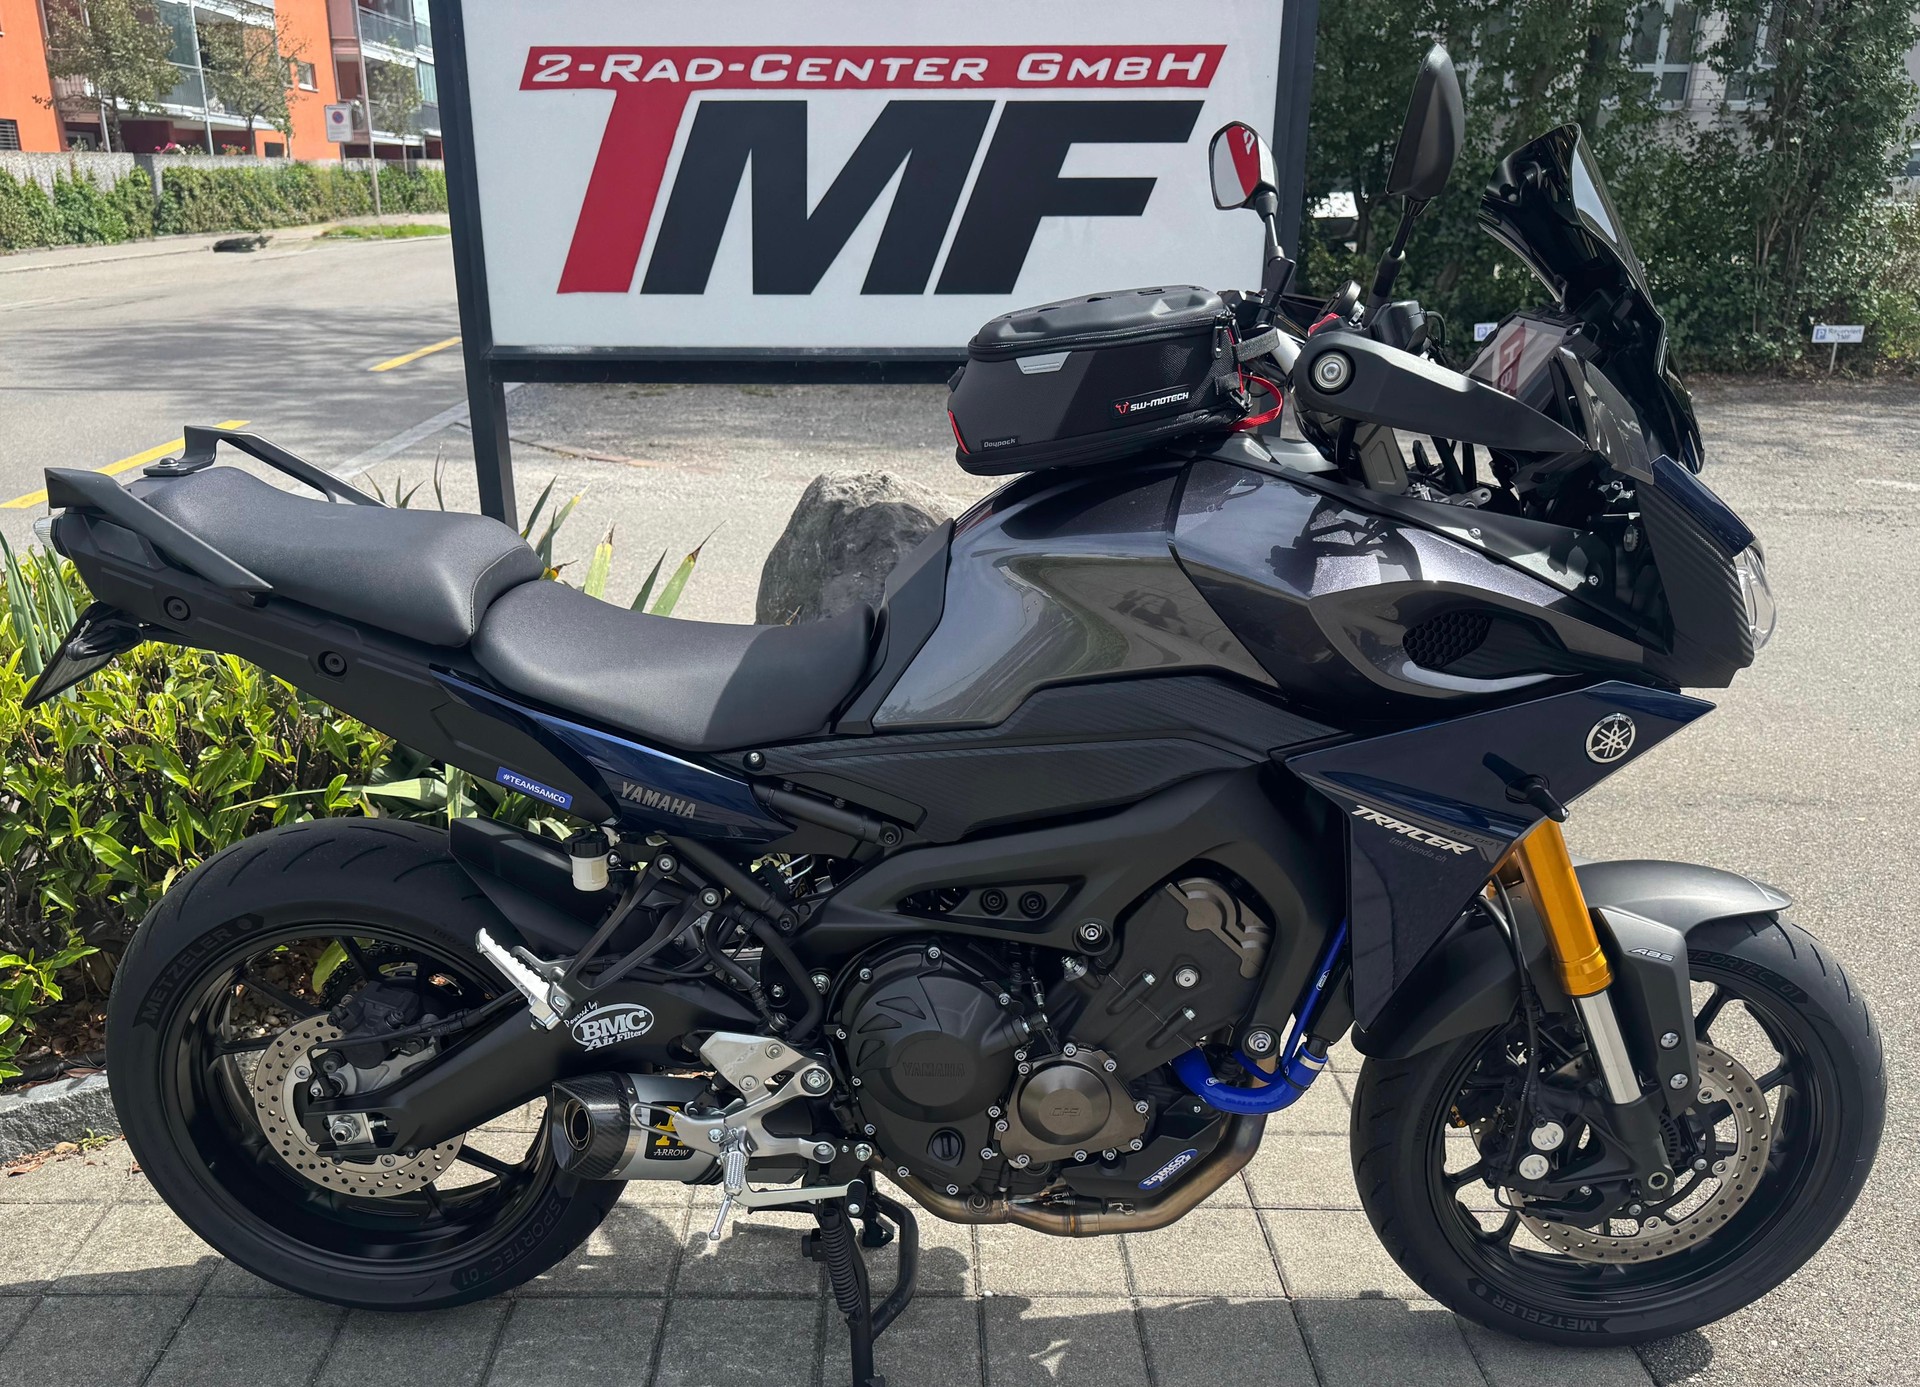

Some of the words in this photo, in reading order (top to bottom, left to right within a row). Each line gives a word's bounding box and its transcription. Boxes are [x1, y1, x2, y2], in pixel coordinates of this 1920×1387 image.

[556, 88, 1205, 295] TMF
[1129, 392, 1189, 411] SW-MOTECH
[503, 773, 566, 804] #TEAMSAMCO
[621, 781, 697, 818] YAMAHA
[1351, 804, 1475, 856] TRACER
[1389, 836, 1448, 863] tmf-honda.ch
[1631, 949, 1674, 962] ABS
[142, 928, 232, 1019] METZELER
[580, 1010, 648, 1041] BMC
[584, 1036, 616, 1052] Air
[903, 1062, 965, 1078] YAMAHA
[653, 1149, 689, 1157] ARROW
[491, 1199, 561, 1271] SPORTEC
[1492, 1295, 1597, 1331] METZELER
